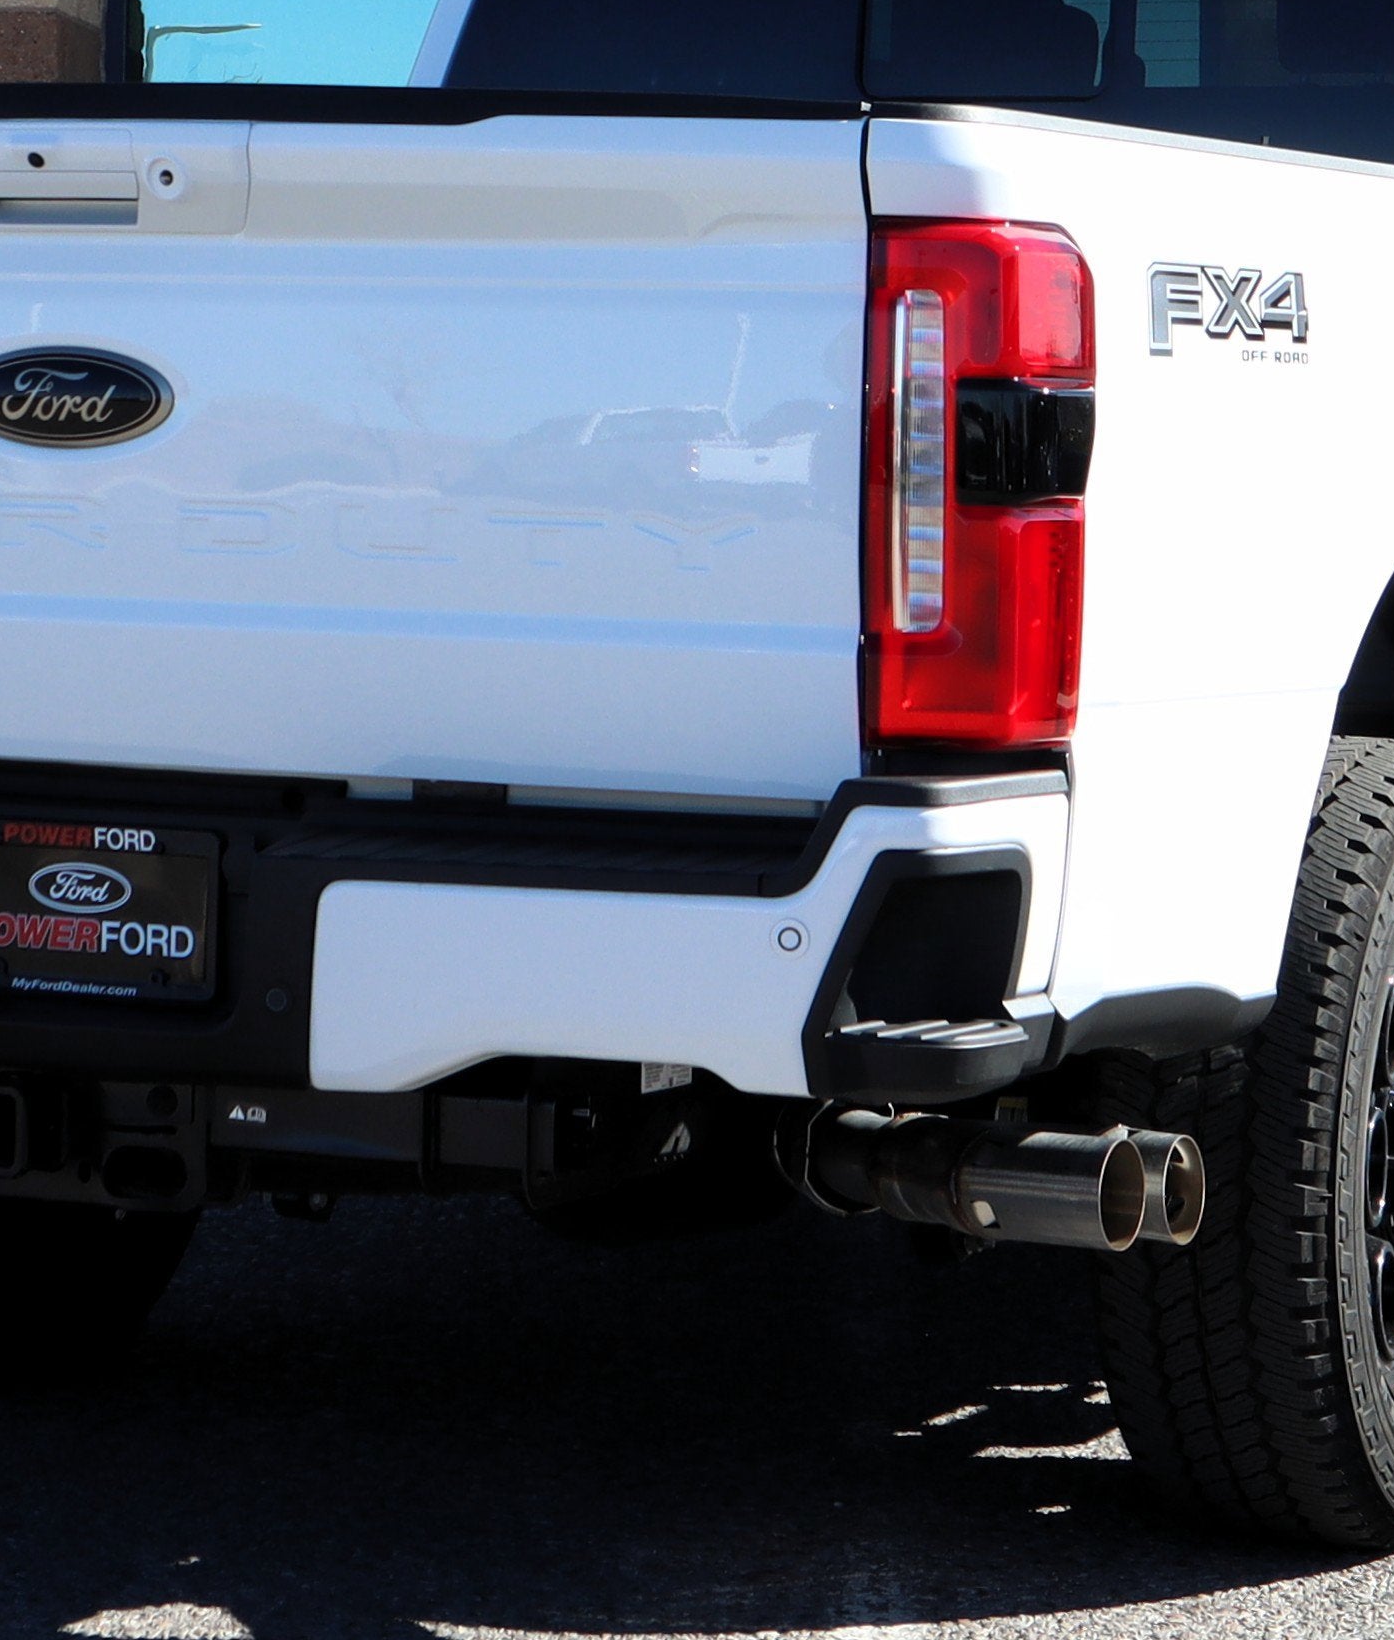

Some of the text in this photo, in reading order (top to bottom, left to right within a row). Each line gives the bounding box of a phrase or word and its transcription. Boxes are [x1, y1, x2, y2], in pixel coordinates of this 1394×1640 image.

[1147, 261, 1309, 357] FX4
[1241, 349, 1309, 365] OFF ROAD
[1, 367, 116, 423] Ford
[178, 498, 760, 571] DUTY
[2, 822, 157, 852] POWERFORD
[49, 869, 111, 903] Ford
[11, 976, 138, 998] MyFordDealer.com
